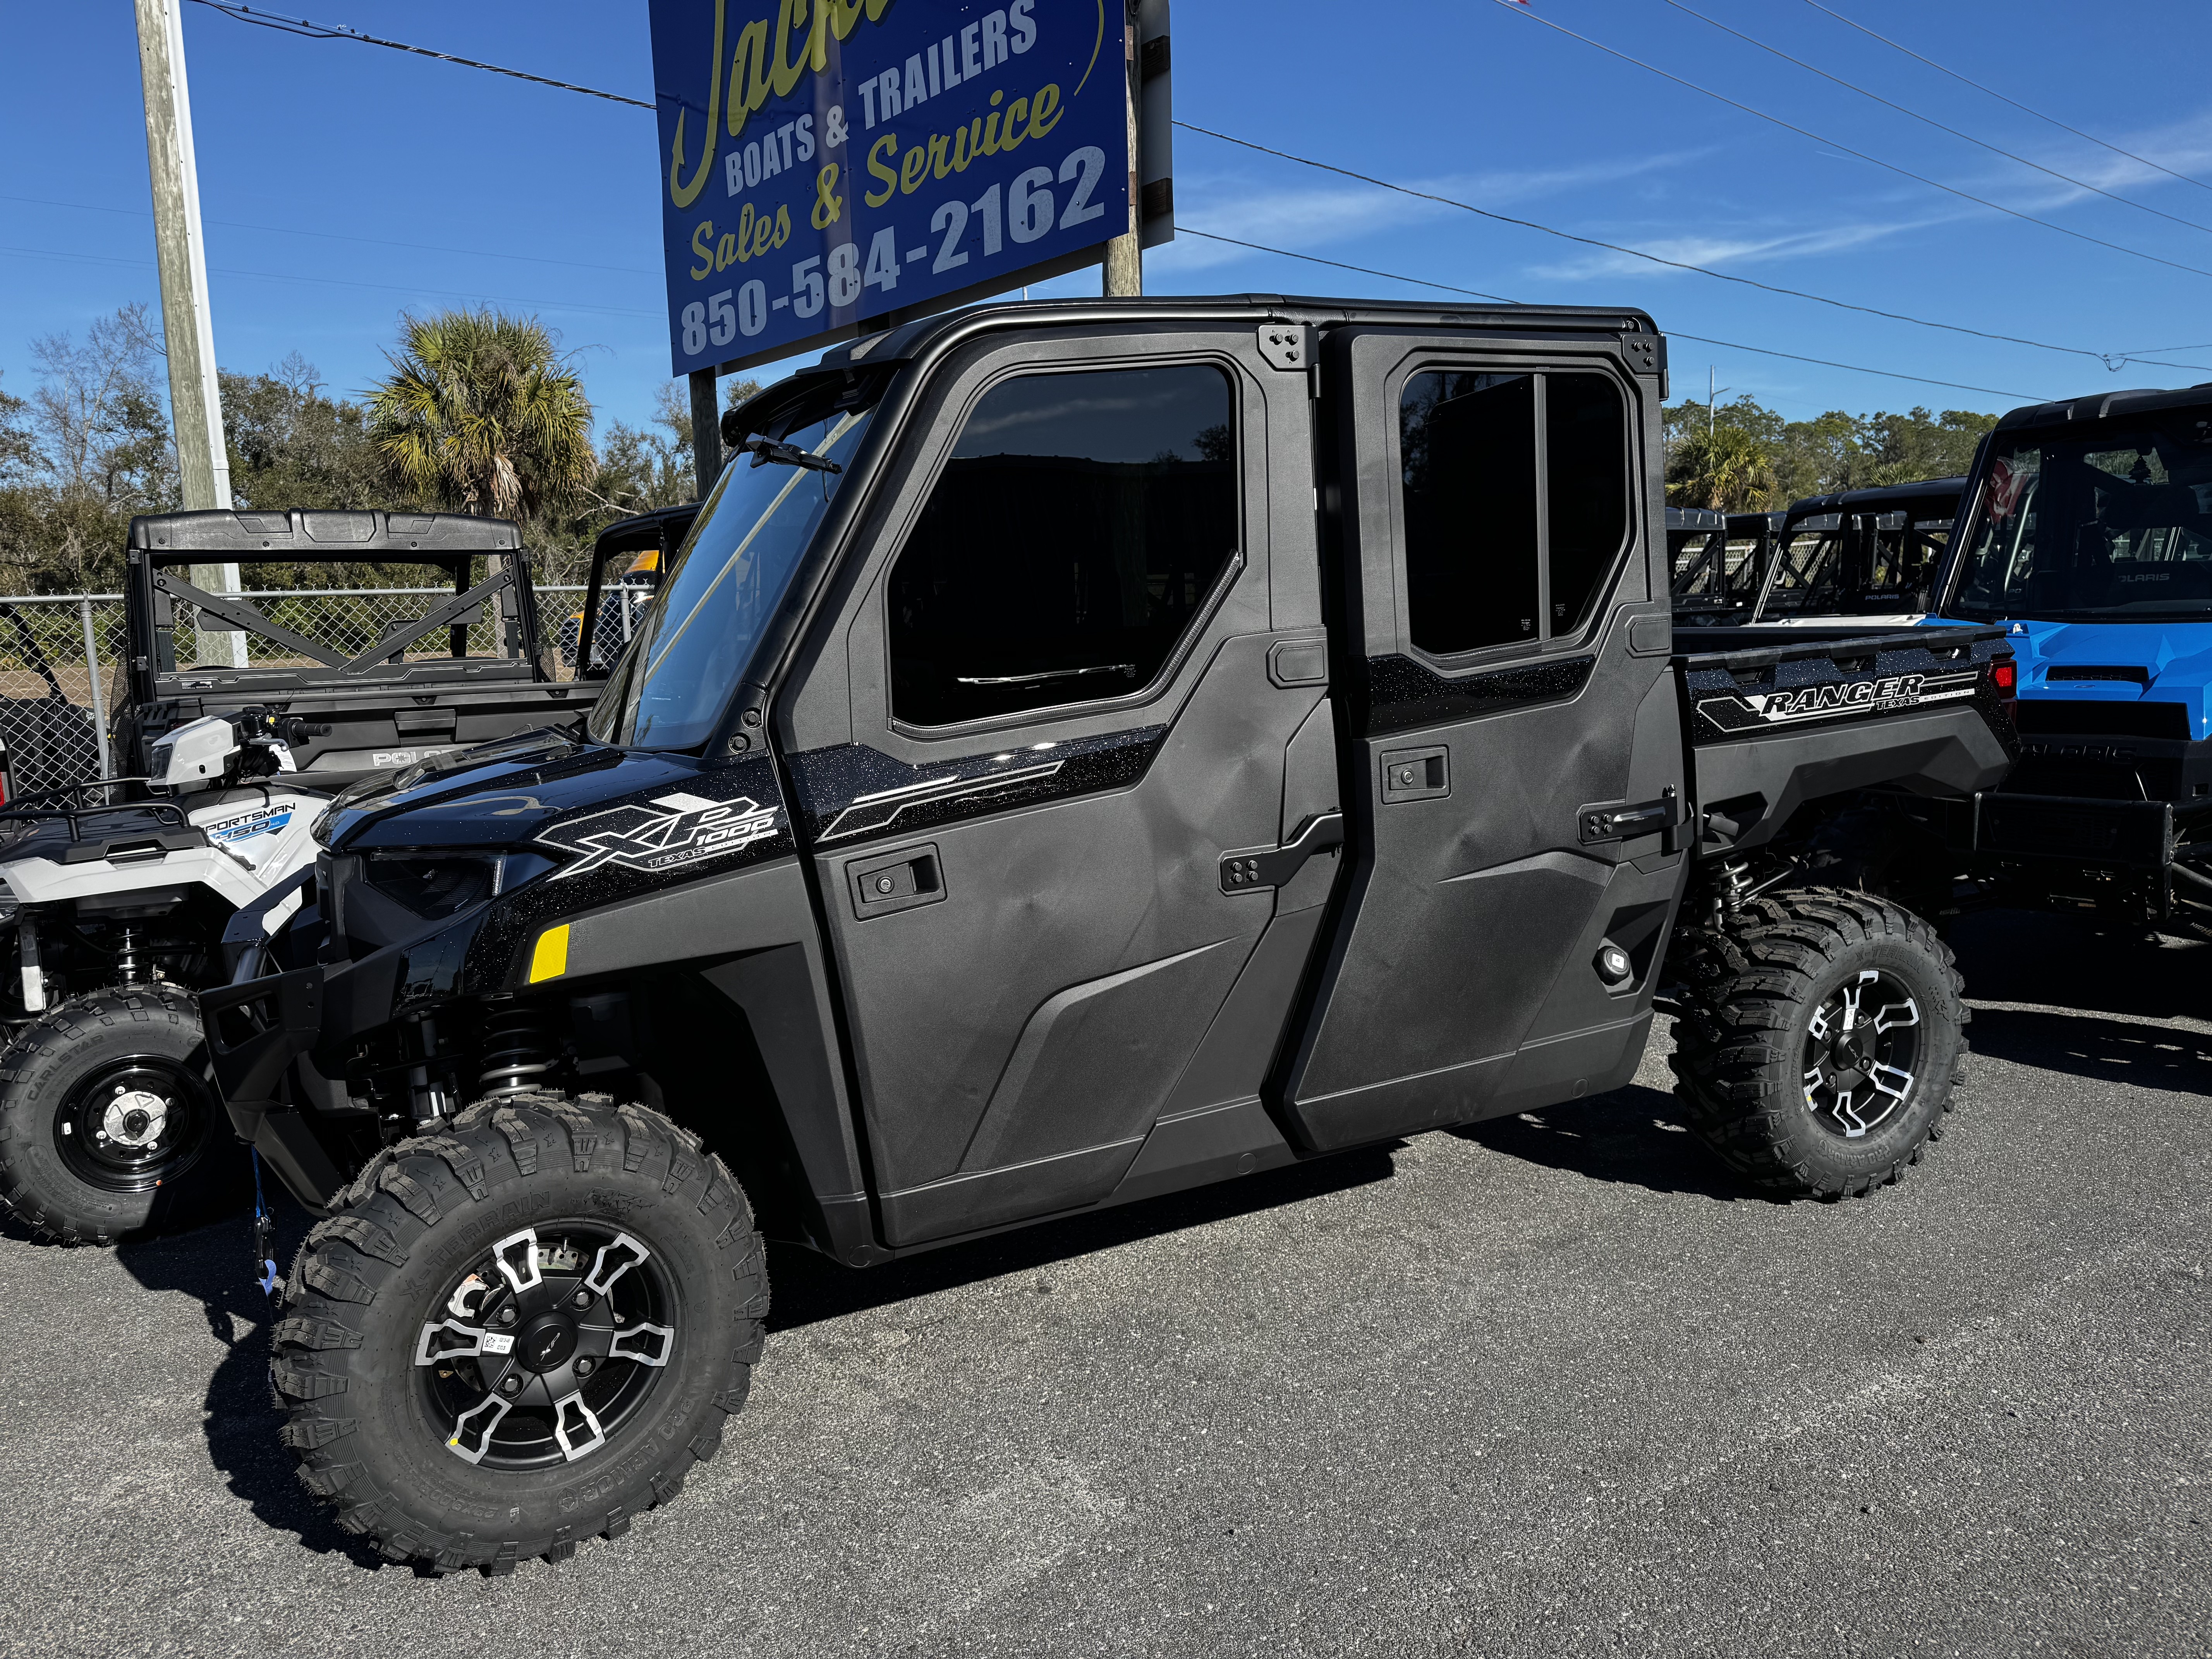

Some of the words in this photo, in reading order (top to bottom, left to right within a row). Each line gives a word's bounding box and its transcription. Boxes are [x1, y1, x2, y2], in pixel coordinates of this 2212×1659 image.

[725, 113, 815, 198] BOATS
[826, 105, 849, 148] &
[858, 0, 1037, 130] TRAILERS
[690, 203, 791, 281] Sales
[811, 162, 842, 230] &
[864, 83, 1064, 208] Service
[681, 146, 1105, 356] 850-584-2162
[1759, 674, 1925, 717] RANGER
[1876, 696, 1921, 710] TEXAS
[1924, 690, 1970, 700] EDITION
[216, 820, 270, 840] 450
[696, 817, 774, 846] 1000
[648, 846, 706, 868] TEXAS
[1855, 944, 1925, 974] X-TERRAIN
[27, 1035, 105, 1101] CARLSTAR
[399, 1190, 552, 1302] X-TERRAIN
[658, 1396, 696, 1441] PRO
[580, 1437, 661, 1502] ARMOR
